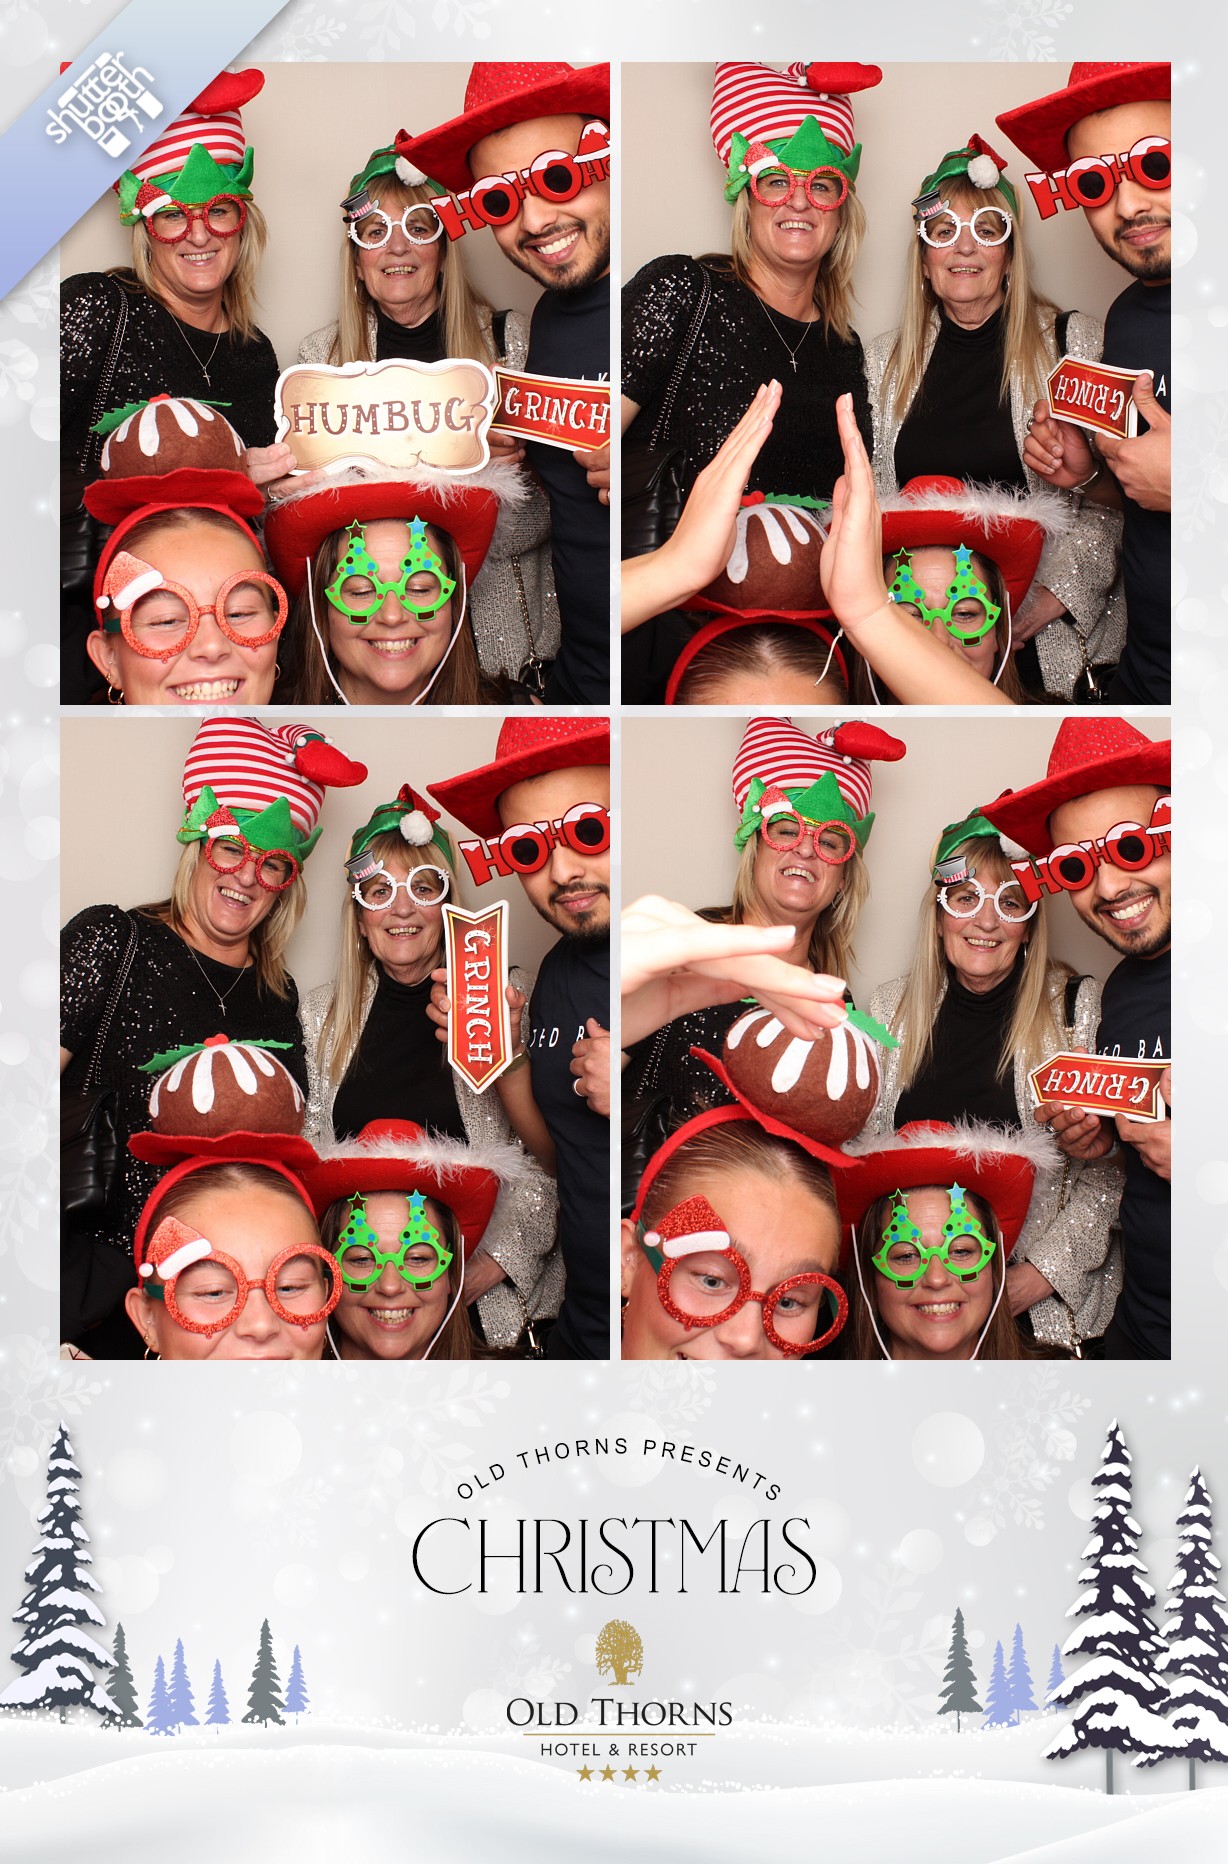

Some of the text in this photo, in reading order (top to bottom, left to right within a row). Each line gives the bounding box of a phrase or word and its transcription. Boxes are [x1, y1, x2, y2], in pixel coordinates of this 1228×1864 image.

[290, 396, 476, 435] HUMBUG
[504, 386, 610, 434] GRINCH
[1054, 374, 1125, 420] GRINCH
[463, 929, 493, 1065] GRINCH
[1043, 1068, 1150, 1105] GRINCH
